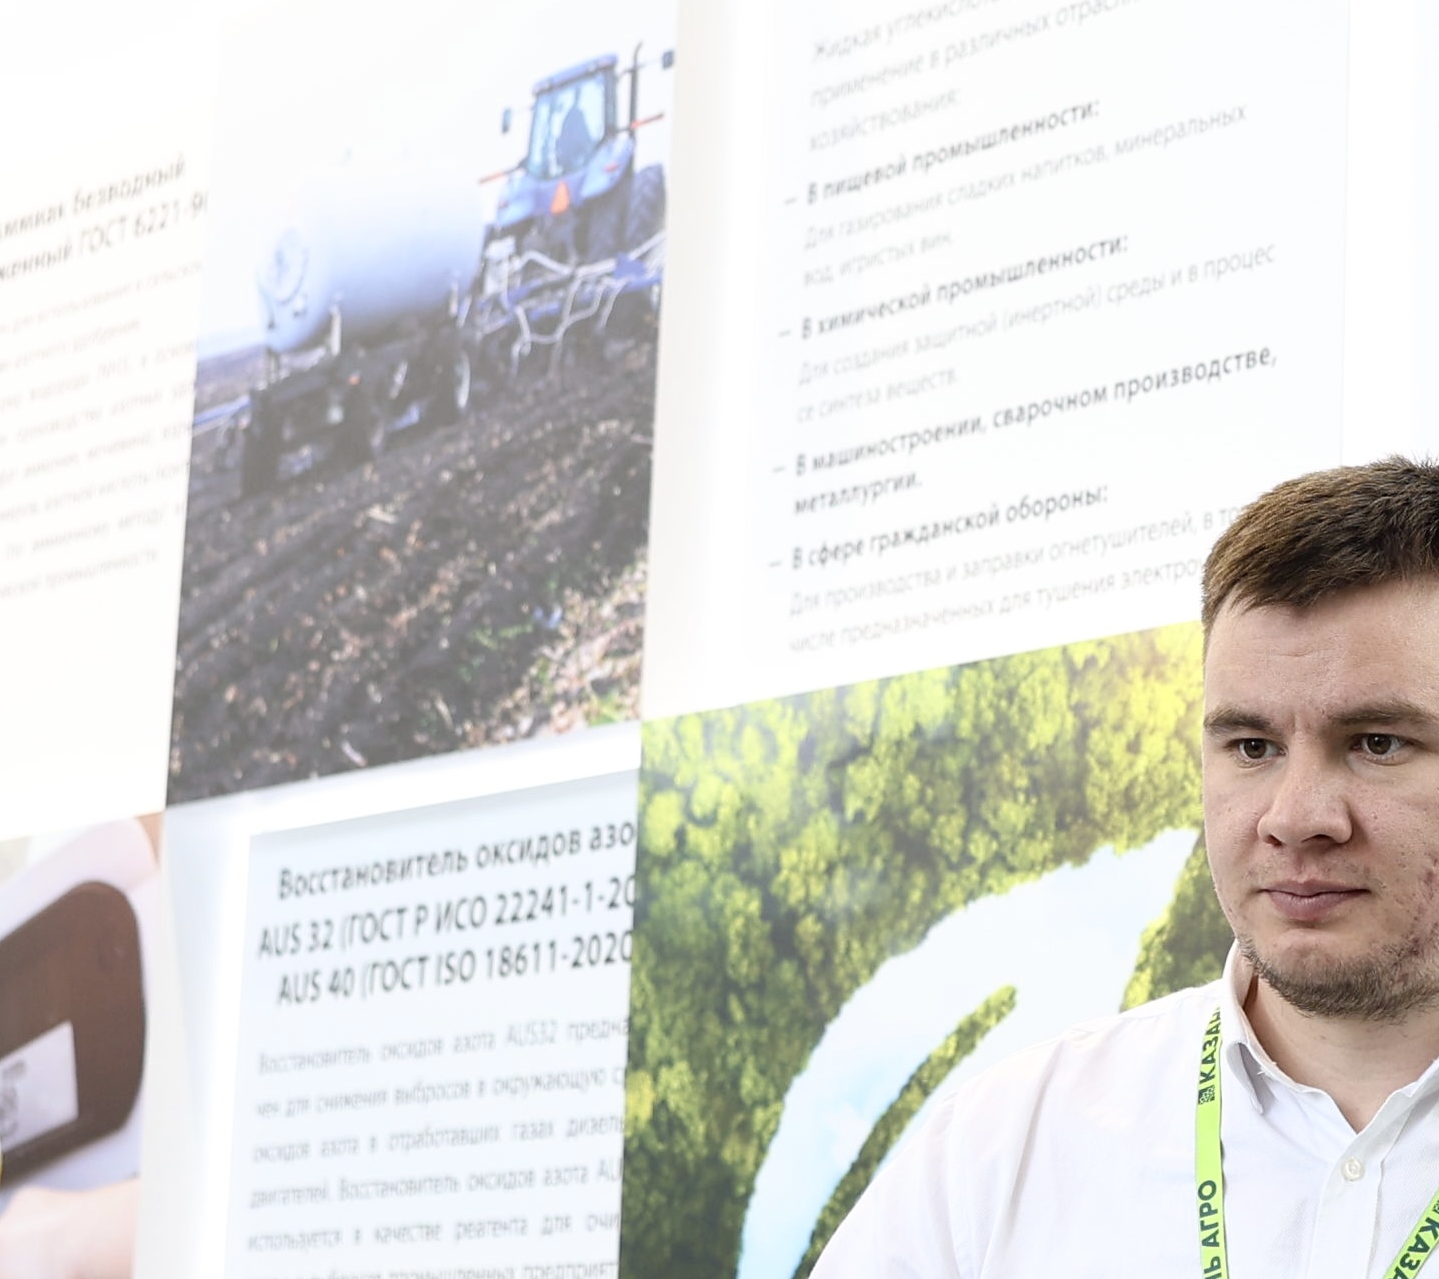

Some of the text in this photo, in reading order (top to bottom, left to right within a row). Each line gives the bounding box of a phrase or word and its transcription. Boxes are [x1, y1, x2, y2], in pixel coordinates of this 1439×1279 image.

[817, 283, 932, 335] химической
[936, 234, 1128, 305] промышленности:
[811, 415, 995, 472] машиностроении,
[992, 385, 1108, 429] сварочном
[1113, 346, 1277, 404] производстве,
[808, 538, 865, 568] сфере
[869, 502, 1000, 556] гражданской
[1005, 485, 1108, 524] обороны:
[277, 849, 470, 901] Восстановитель
[474, 828, 582, 870] оксидов
[1199, 1006, 1221, 1085] КАЗАН
[1197, 1179, 1221, 1248] АГРО
